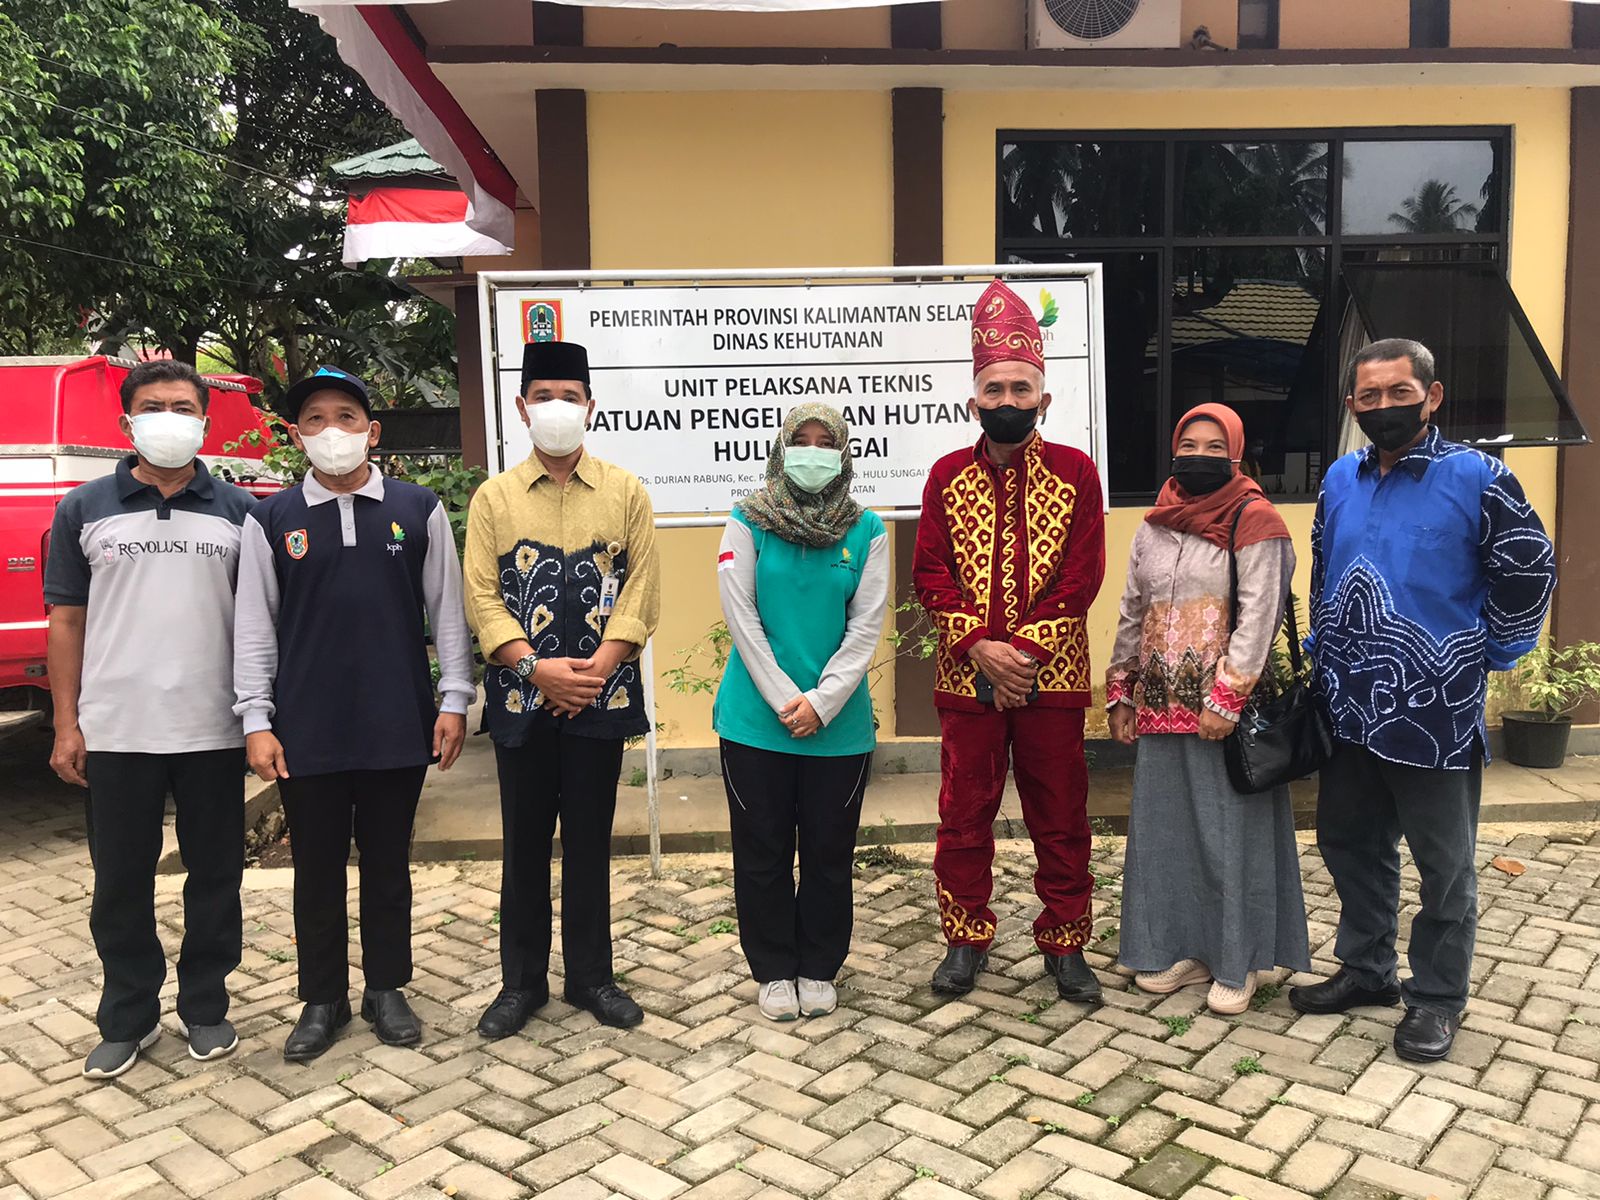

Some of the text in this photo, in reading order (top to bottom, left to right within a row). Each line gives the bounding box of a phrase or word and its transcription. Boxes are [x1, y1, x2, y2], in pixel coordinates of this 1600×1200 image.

[589, 304, 975, 328] PEMERINTAH PROVINSI KALIMANTAN SELAT
[713, 330, 883, 351] DINAS KEHUTANAN
[664, 373, 933, 398] UNIT PELAKSANA TEKNIS
[585, 409, 681, 432] ATUAN
[884, 403, 970, 425] HUTAN
[654, 475, 691, 485] DURIAN
[693, 473, 736, 484] RABUNG,
[738, 473, 757, 483] Kec.
[863, 469, 888, 479] HULU
[890, 467, 925, 478] SUNGAI
[118, 541, 229, 562] REVOLUSI HIJAU
[386, 543, 403, 556] kph
